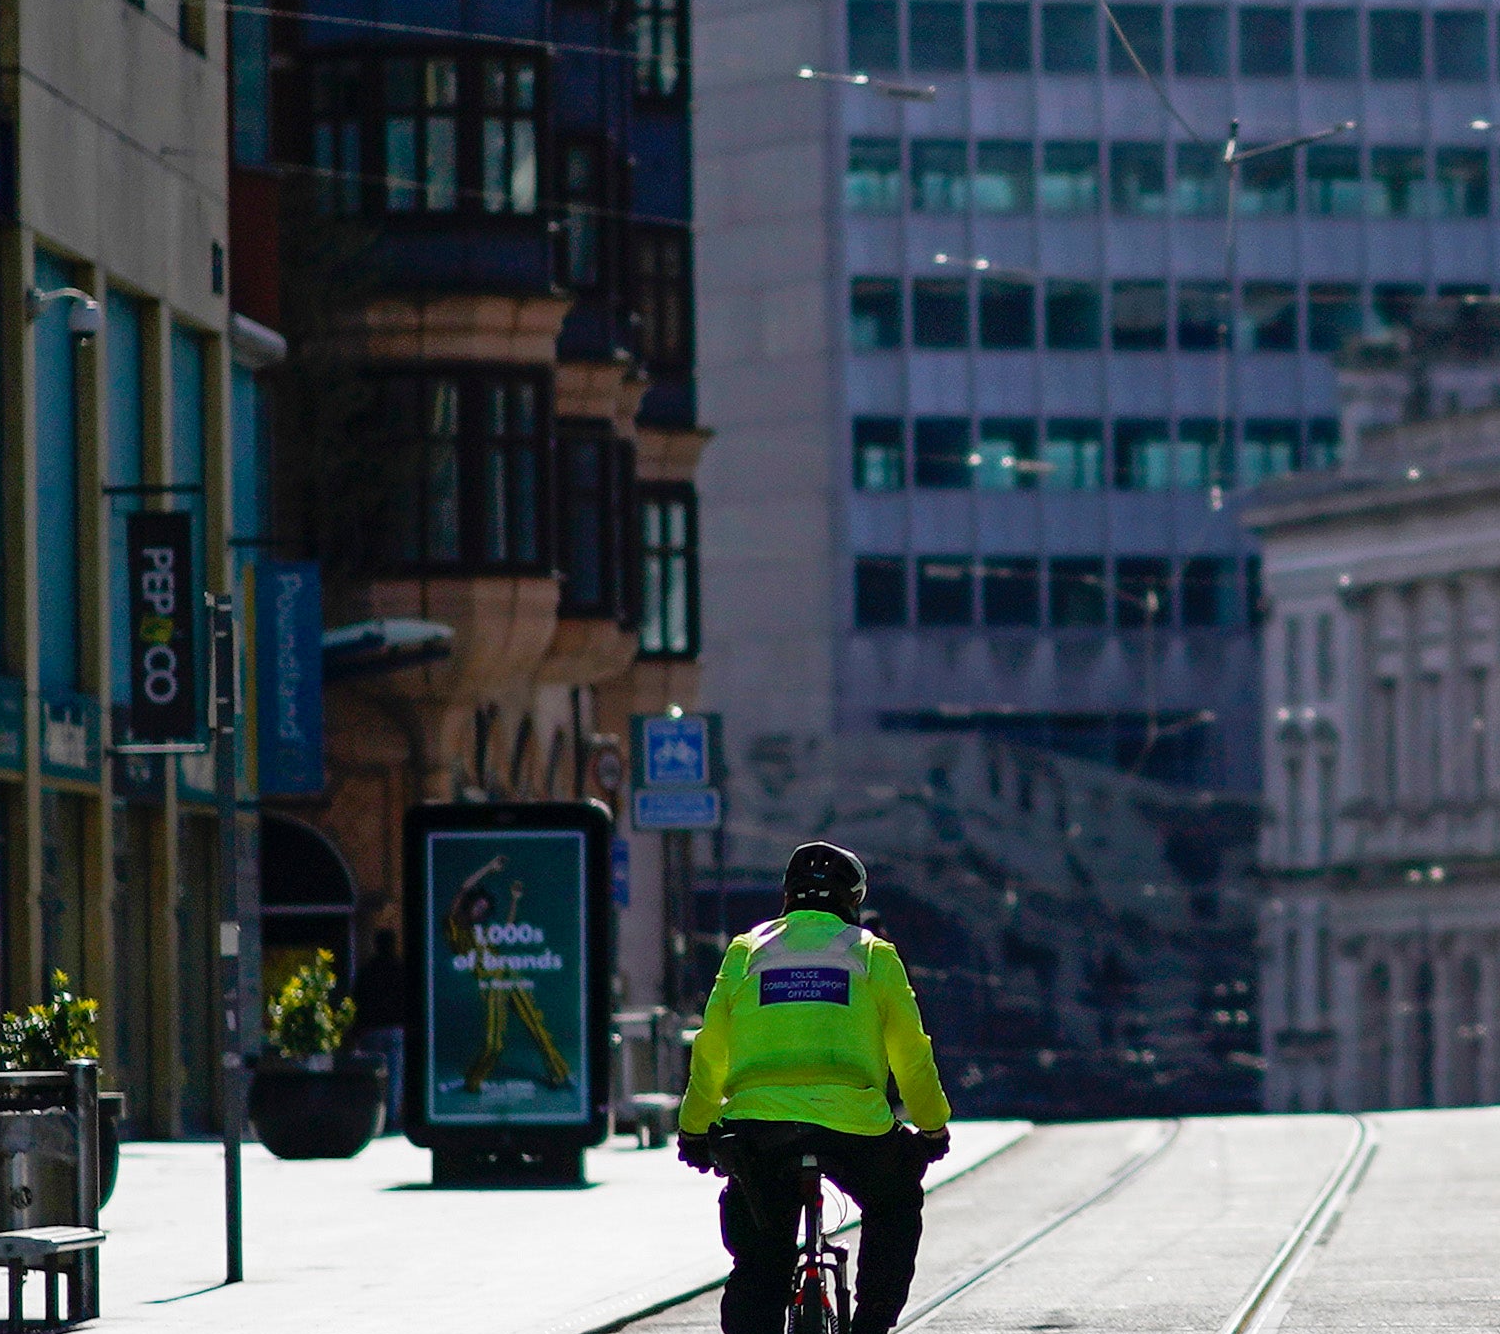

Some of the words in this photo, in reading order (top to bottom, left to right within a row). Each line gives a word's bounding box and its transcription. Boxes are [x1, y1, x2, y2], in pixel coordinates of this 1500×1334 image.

[790, 970, 819, 979] POLICE
[763, 980, 809, 991] COMMUNITY
[811, 980, 847, 989] SUPPORT
[787, 990, 821, 999] OFFICER
